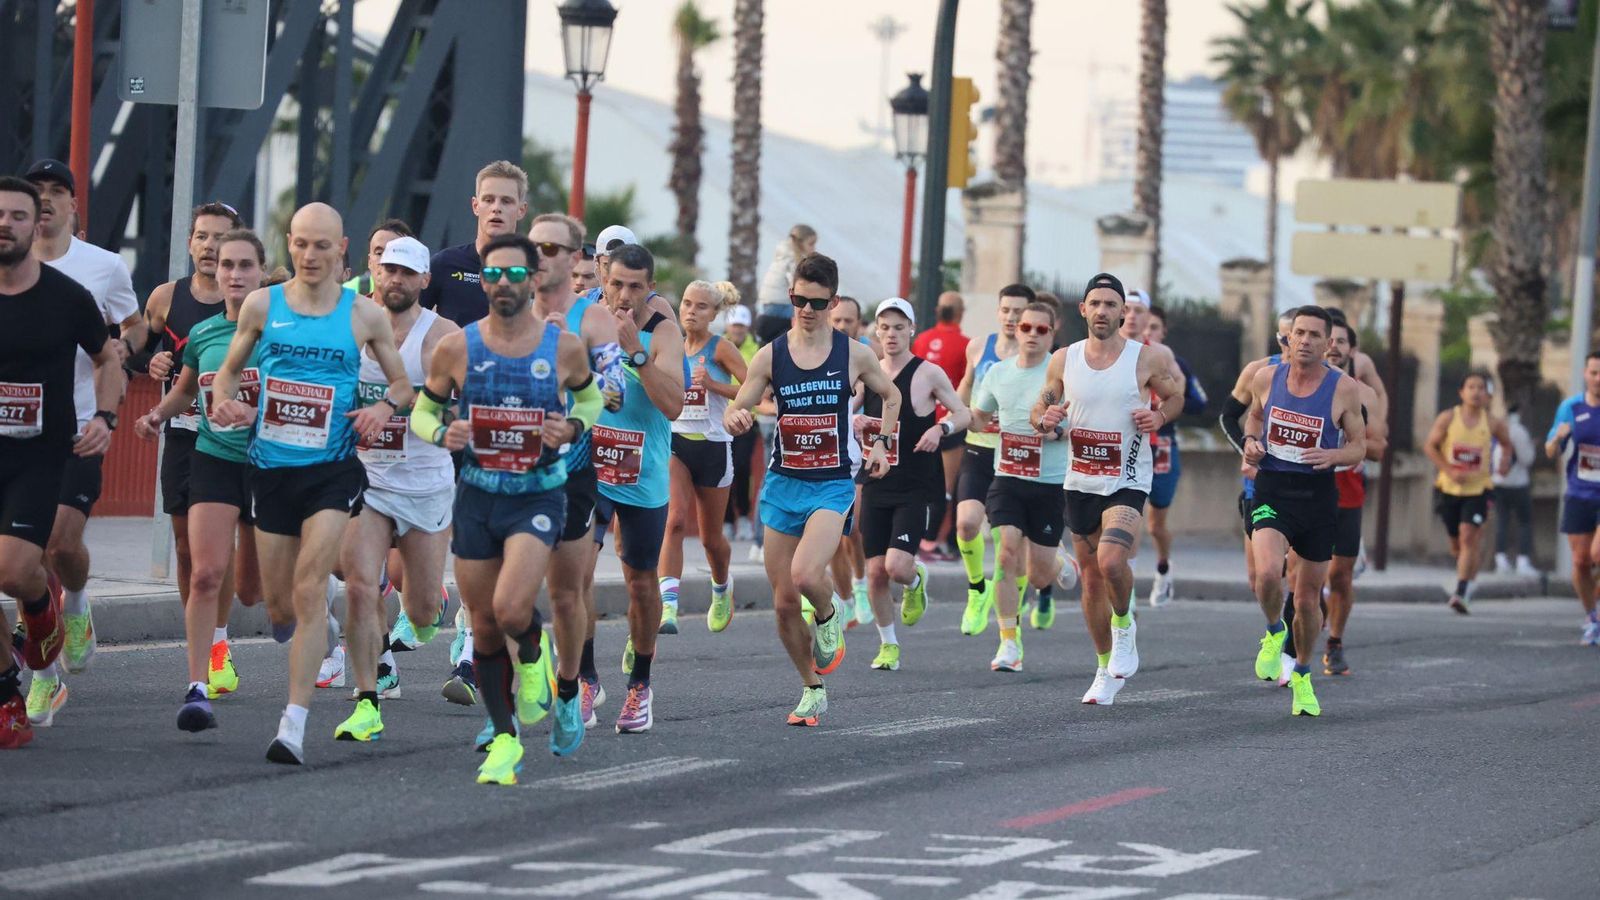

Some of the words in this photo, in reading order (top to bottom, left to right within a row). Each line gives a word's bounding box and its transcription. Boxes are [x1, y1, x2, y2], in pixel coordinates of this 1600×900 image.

[269, 343, 345, 361] SPARTA
[0, 386, 36, 397] NERALI
[281, 383, 330, 398] GENERALI
[780, 380, 841, 396] COLLEGEVILLE
[785, 395, 813, 409] TRACK
[815, 394, 839, 405] CLUB
[275, 402, 316, 419] 14324
[490, 410, 539, 422] GENERALI
[793, 416, 832, 426] GENERALI
[1282, 412, 1319, 427] GENERALI
[489, 430, 525, 444] 1326
[599, 429, 640, 442] GENERALI
[794, 434, 822, 445] 7876
[1082, 431, 1118, 441] GENERALI
[1277, 427, 1309, 442] 12107
[596, 446, 625, 461] 6401
[1007, 447, 1029, 458] 2800
[1082, 445, 1108, 457] 3168
[1125, 433, 1143, 483] TERREX
[246, 852, 1275, 900] ASICA
